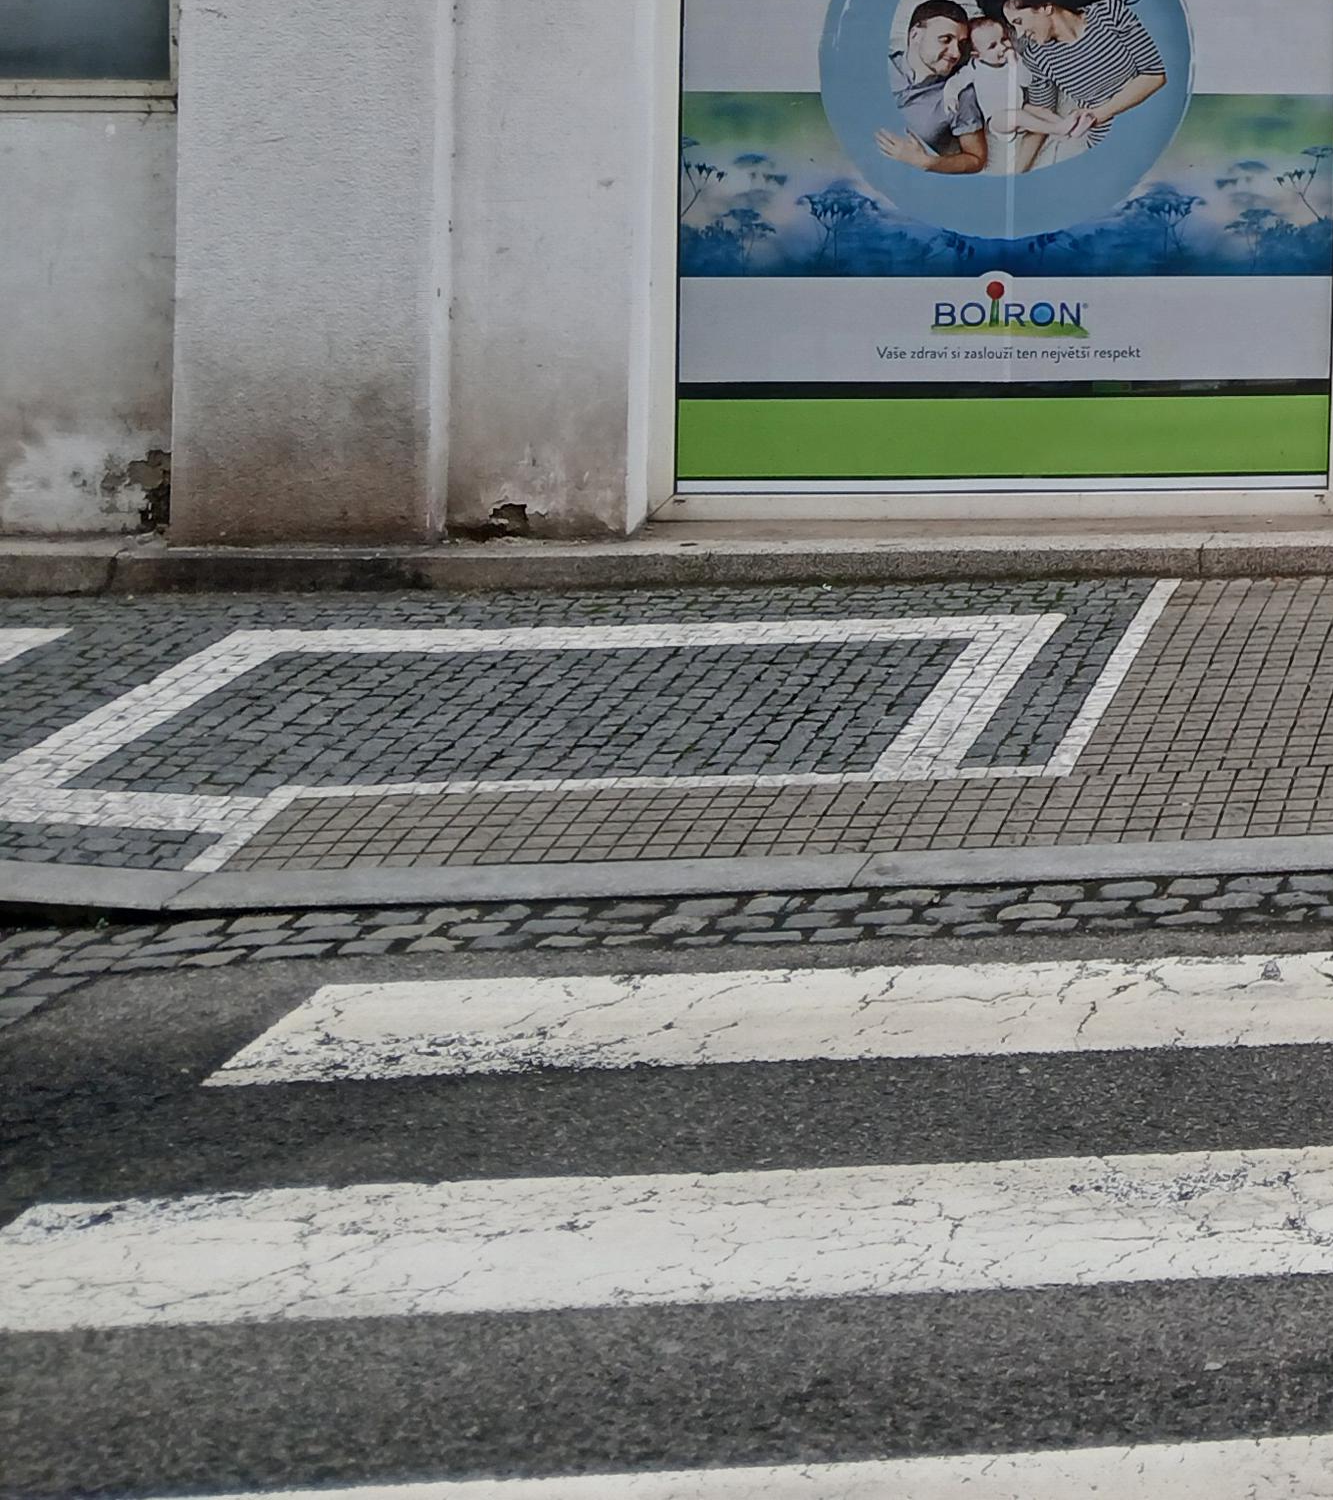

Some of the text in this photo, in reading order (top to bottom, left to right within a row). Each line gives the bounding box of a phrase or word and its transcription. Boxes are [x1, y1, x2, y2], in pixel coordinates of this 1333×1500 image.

[876, 345, 1142, 364] Vaše zdraví si zaslouží ten největší respekt
